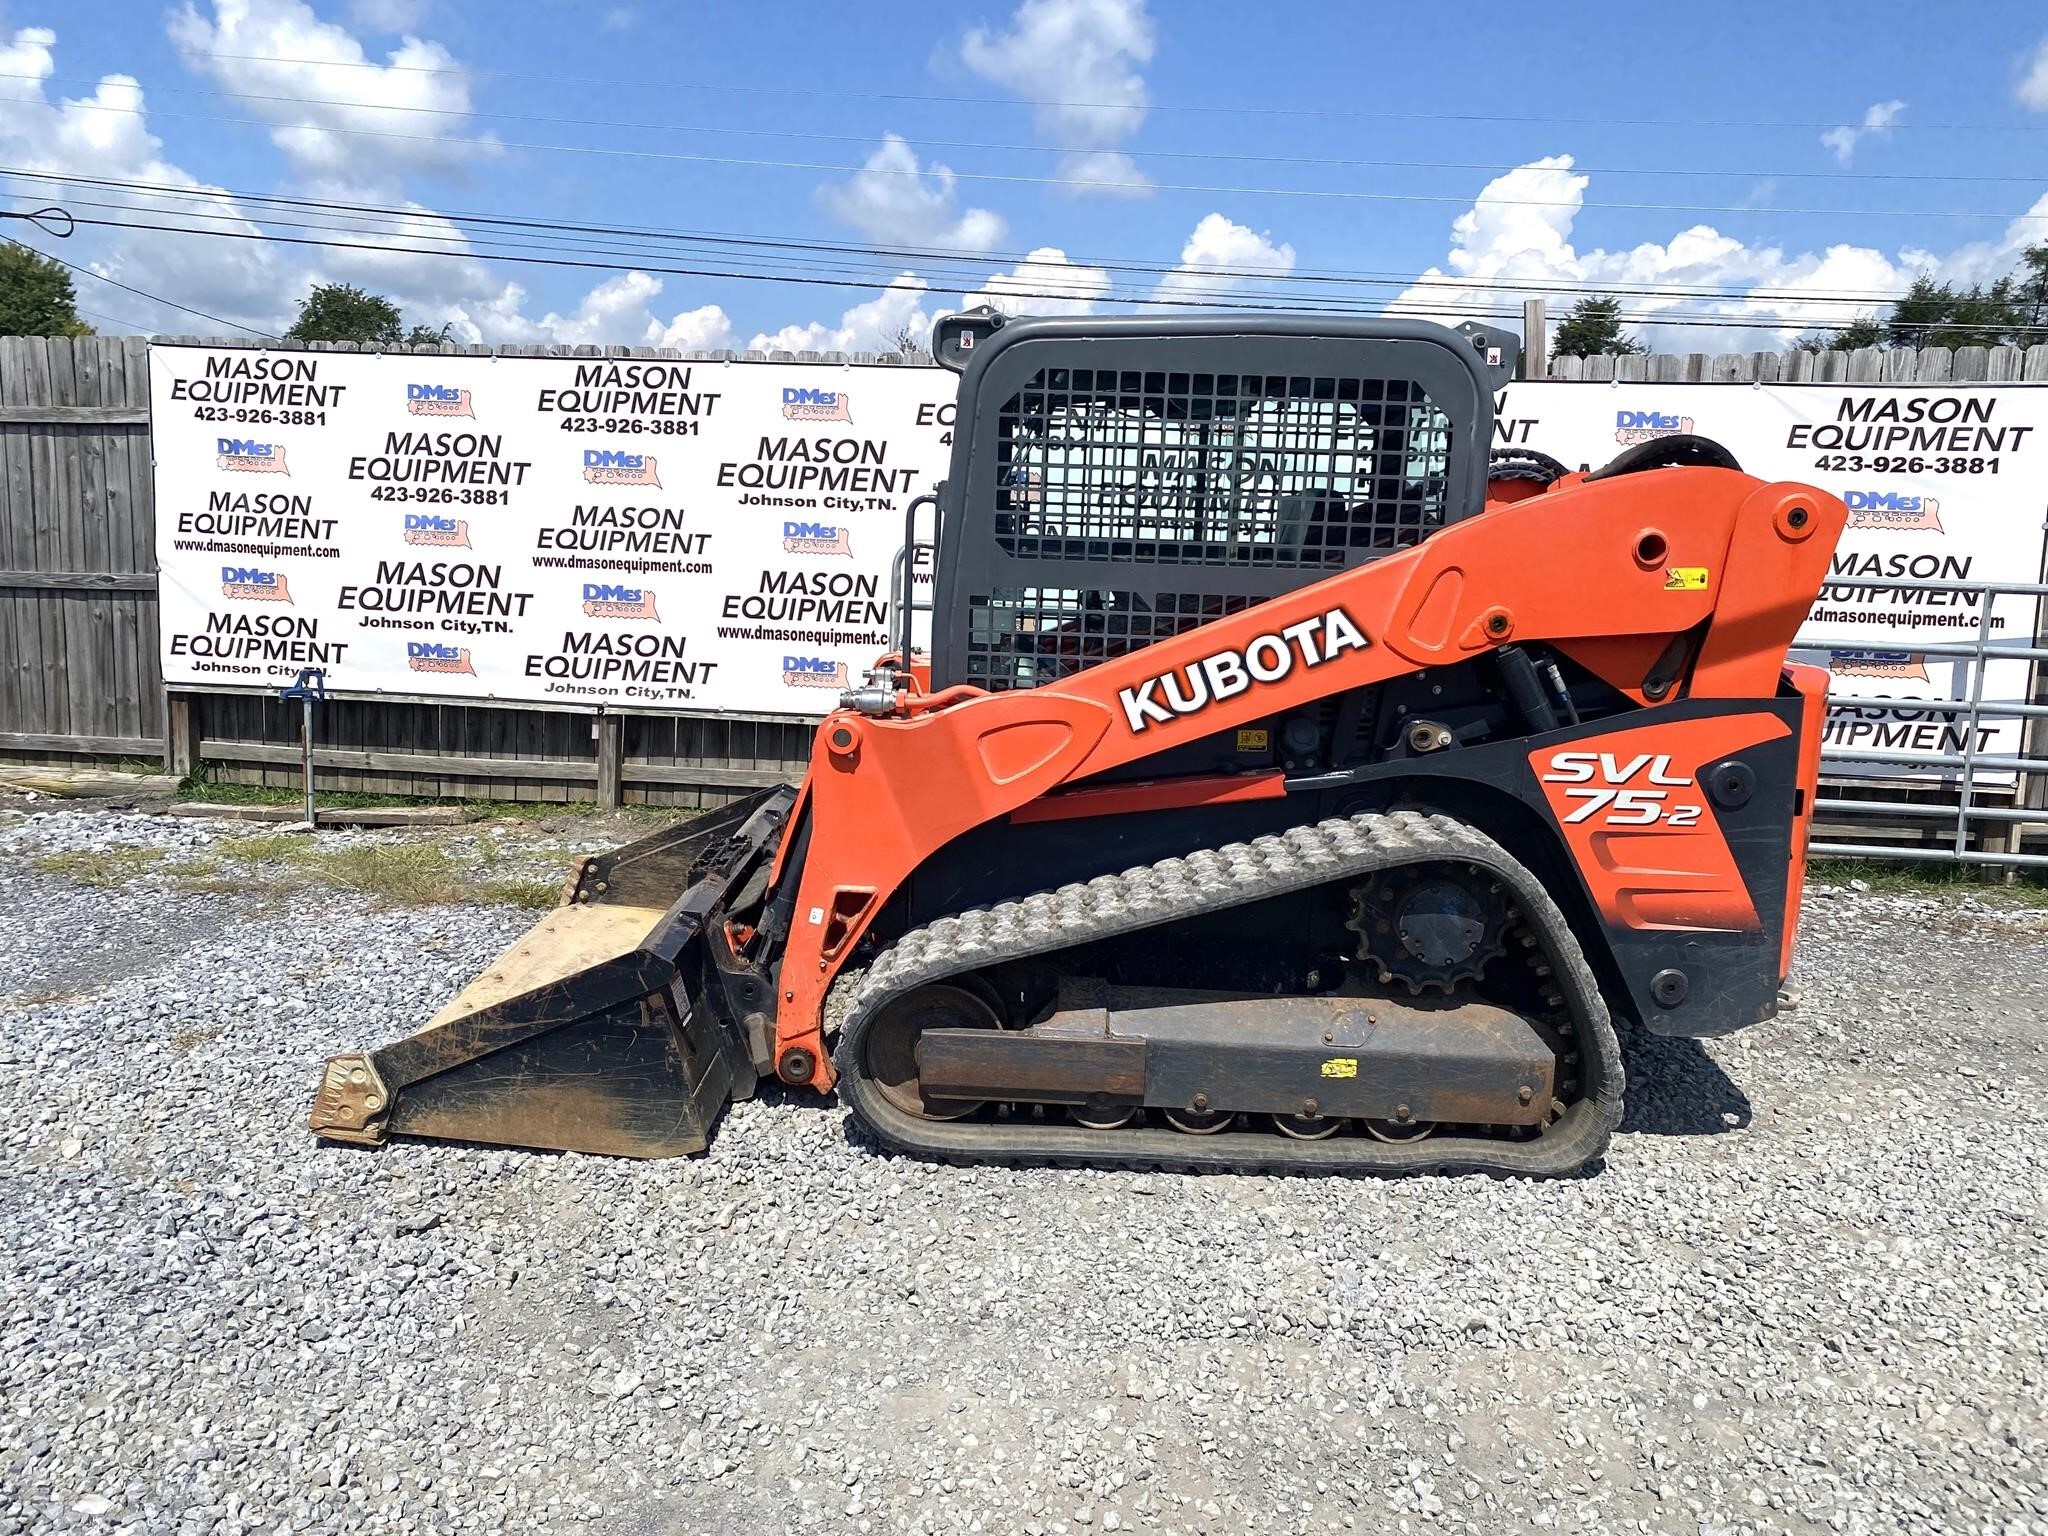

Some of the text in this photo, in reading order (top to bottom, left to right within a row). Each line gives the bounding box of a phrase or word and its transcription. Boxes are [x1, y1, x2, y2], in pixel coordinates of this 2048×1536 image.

[206, 357, 317, 381] MASON
[575, 365, 691, 389] MASON
[171, 379, 346, 407] EQUIPMENT
[538, 390, 721, 415] EQUIPMENT
[194, 407, 325, 425] 423-926-3881
[1837, 398, 1996, 423] MASON
[561, 418, 698, 435] 423-926-3881
[1787, 425, 2033, 451] EQUIPMENT
[385, 432, 501, 458] MASON
[758, 437, 887, 464] MASON
[349, 457, 531, 485] EQUIPMENT
[1815, 455, 1999, 474] 423-926-3881
[717, 463, 919, 493] EQUIPMENT
[209, 491, 311, 515] MASON
[371, 486, 508, 505] 423-926-3881
[739, 494, 816, 507] Johnson
[178, 513, 338, 539] EQUIPMENT
[572, 506, 684, 529] MASON
[174, 539, 340, 558] www.dmasonequipment.com
[537, 528, 712, 554] EQUIPMENT
[376, 561, 501, 588] MASON
[533, 555, 712, 574] www.dmasonequipment.com
[760, 571, 878, 597] MASON
[338, 586, 533, 616] EQUIPMENT
[722, 596, 888, 624] EQUIPMEN
[206, 613, 317, 639] MASON
[359, 616, 434, 630] Johnson
[717, 625, 888, 647] www.dmasonequipment.c
[171, 635, 348, 664] EQUIPMENT
[563, 632, 686, 658] MASON
[191, 661, 262, 674] Johnson
[525, 655, 717, 684] EQUIPMENT
[1118, 608, 1370, 733] KUBOTA
[545, 683, 618, 695] Johnson
[1542, 752, 1693, 785] SVL
[1562, 788, 1702, 826] 75-2
